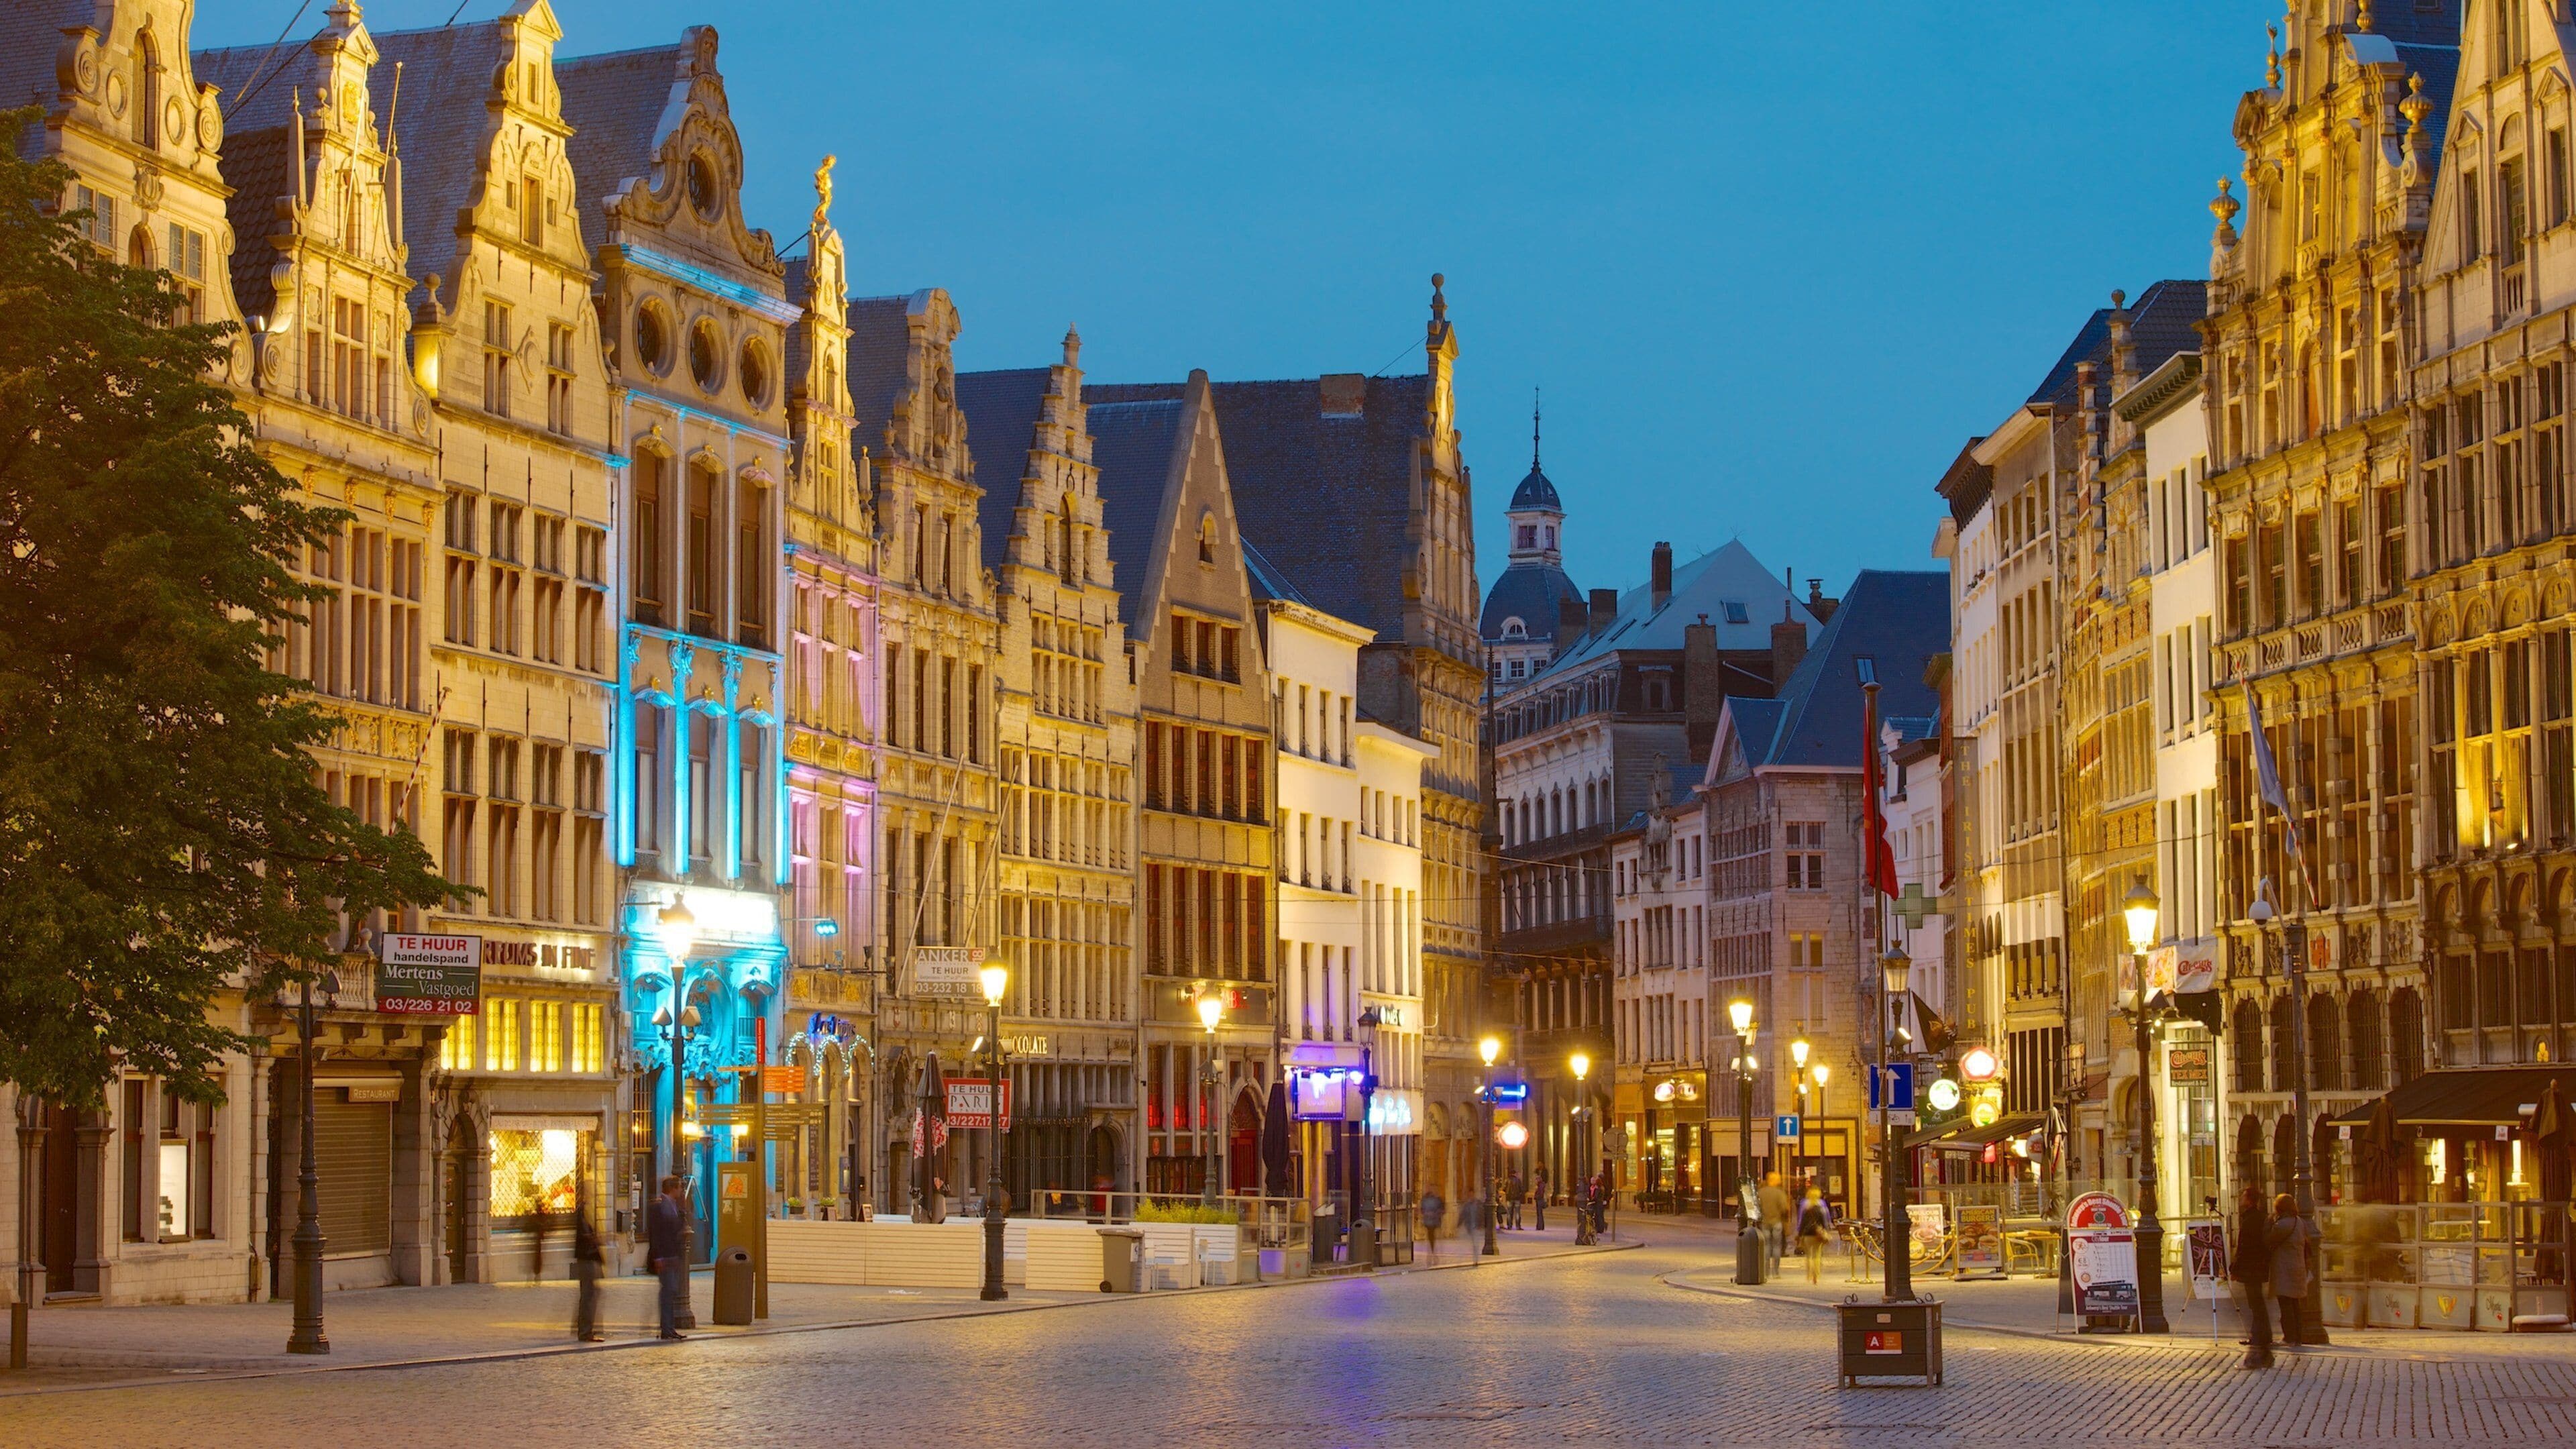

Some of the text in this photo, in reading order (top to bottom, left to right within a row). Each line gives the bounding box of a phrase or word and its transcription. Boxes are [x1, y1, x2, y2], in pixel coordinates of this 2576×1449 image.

[1960, 745, 1976, 1029] THE IRISH TIMES PUB
[397, 936, 467, 951] TE HUUR
[394, 952, 468, 965] handelspand
[541, 944, 557, 967] IN
[561, 946, 596, 971] FINE
[917, 949, 969, 962] ANKER
[385, 965, 443, 980] Mertens
[945, 967, 969, 975] HUUR
[419, 981, 475, 999] Vastgoed
[916, 982, 983, 994] 03-232 18 18
[386, 998, 472, 1012] 03/226 21 02
[2171, 1069, 2207, 1079] TEX MEX
[1870, 1336, 1880, 1347] A
